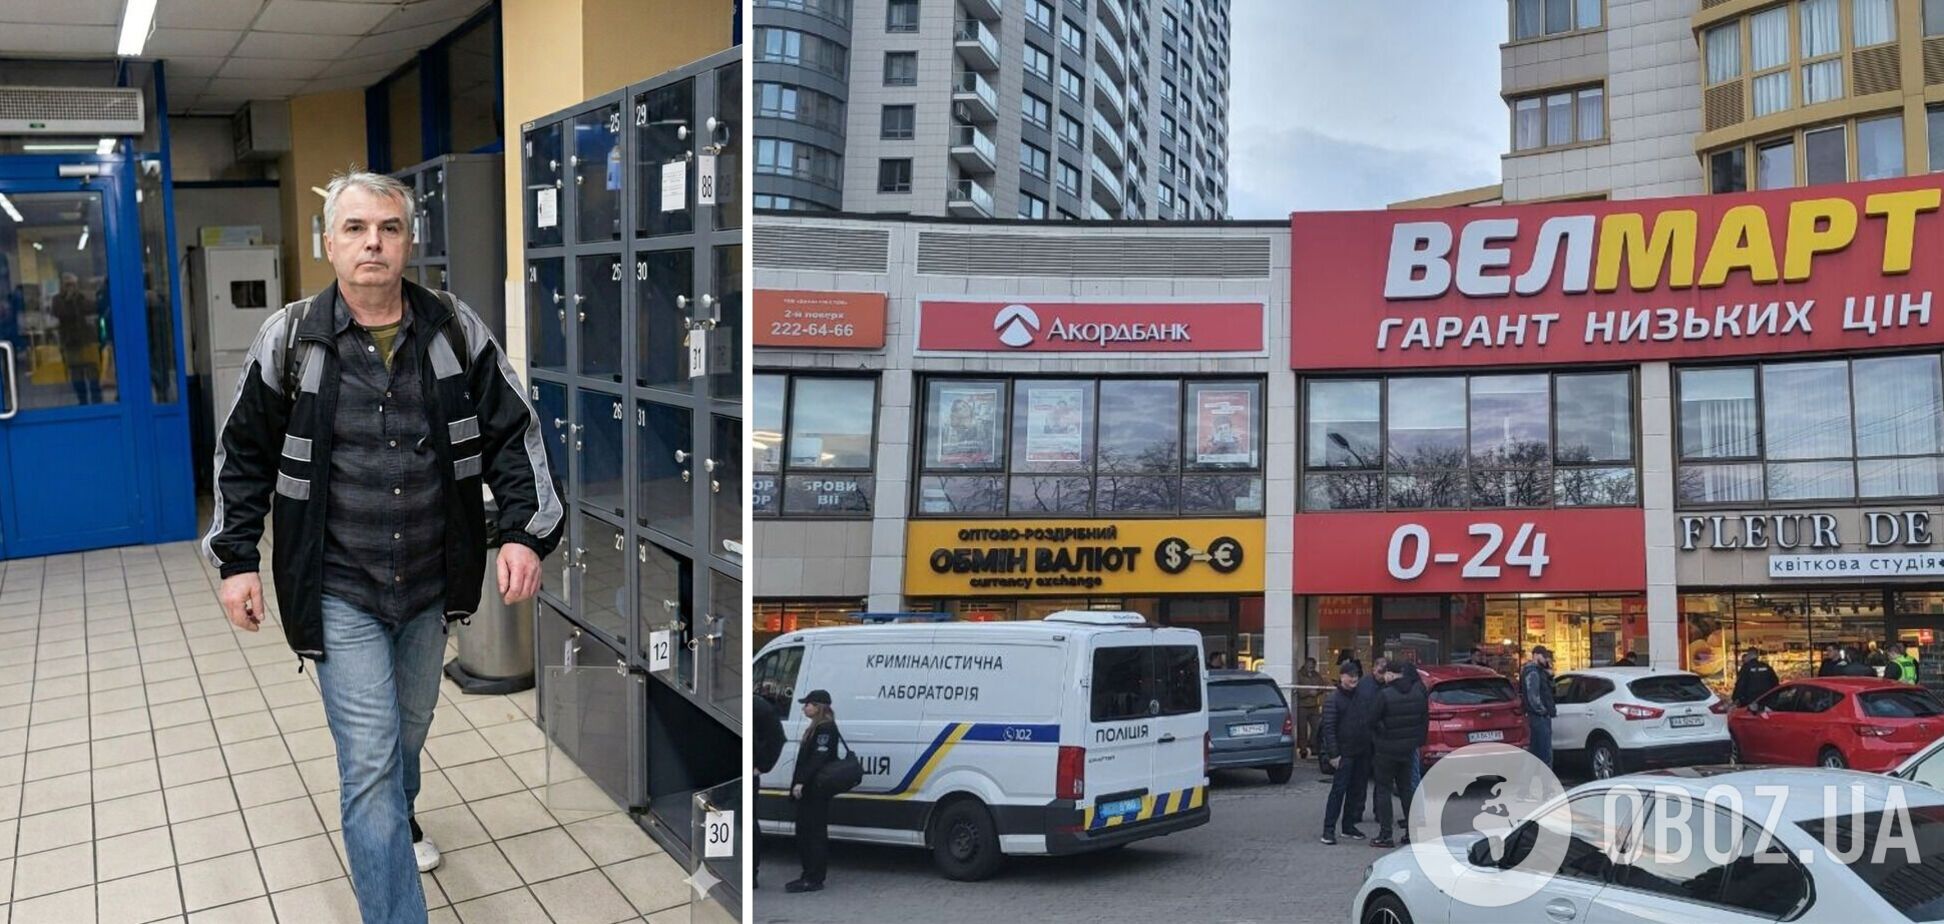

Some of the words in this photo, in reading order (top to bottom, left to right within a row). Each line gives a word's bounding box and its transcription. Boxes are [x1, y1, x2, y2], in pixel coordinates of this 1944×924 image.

[610, 113, 620, 133] 25
[636, 104, 647, 125] 29
[701, 174, 713, 198] 88
[1384, 188, 1942, 300] ВЕЛМАРТ
[636, 262, 648, 281] 30
[771, 321, 854, 337] 222-64-66
[1376, 312, 1560, 350] ГАРАНТ
[1584, 300, 1816, 344] НИЗЬКИХ
[1842, 291, 1933, 335] ЦІН
[612, 402, 623, 420] 26
[637, 408, 646, 427] 31
[958, 525, 1118, 542] ОПТОВО-РОЗДРІБНИЙ
[1680, 513, 1841, 550] FLEUR
[1866, 511, 1933, 547] DE
[929, 546, 1028, 574] ОБМІН
[1035, 545, 1142, 573] ВАЛЮТ
[1386, 522, 1551, 581] 0-24
[1773, 557, 1860, 572] квіткова
[1870, 556, 1936, 573] студія
[970, 577, 1033, 590] currency
[1035, 575, 1103, 589] exchange
[653, 641, 668, 661] 12
[866, 654, 1003, 671] КРИМІНАЛІСТИЧНА
[878, 684, 979, 701] ЛАБОРАТОРІЯ
[1015, 728, 1032, 741] 102
[1095, 724, 1149, 743] ПОЛІЦІЯ
[709, 823, 729, 844] 30
